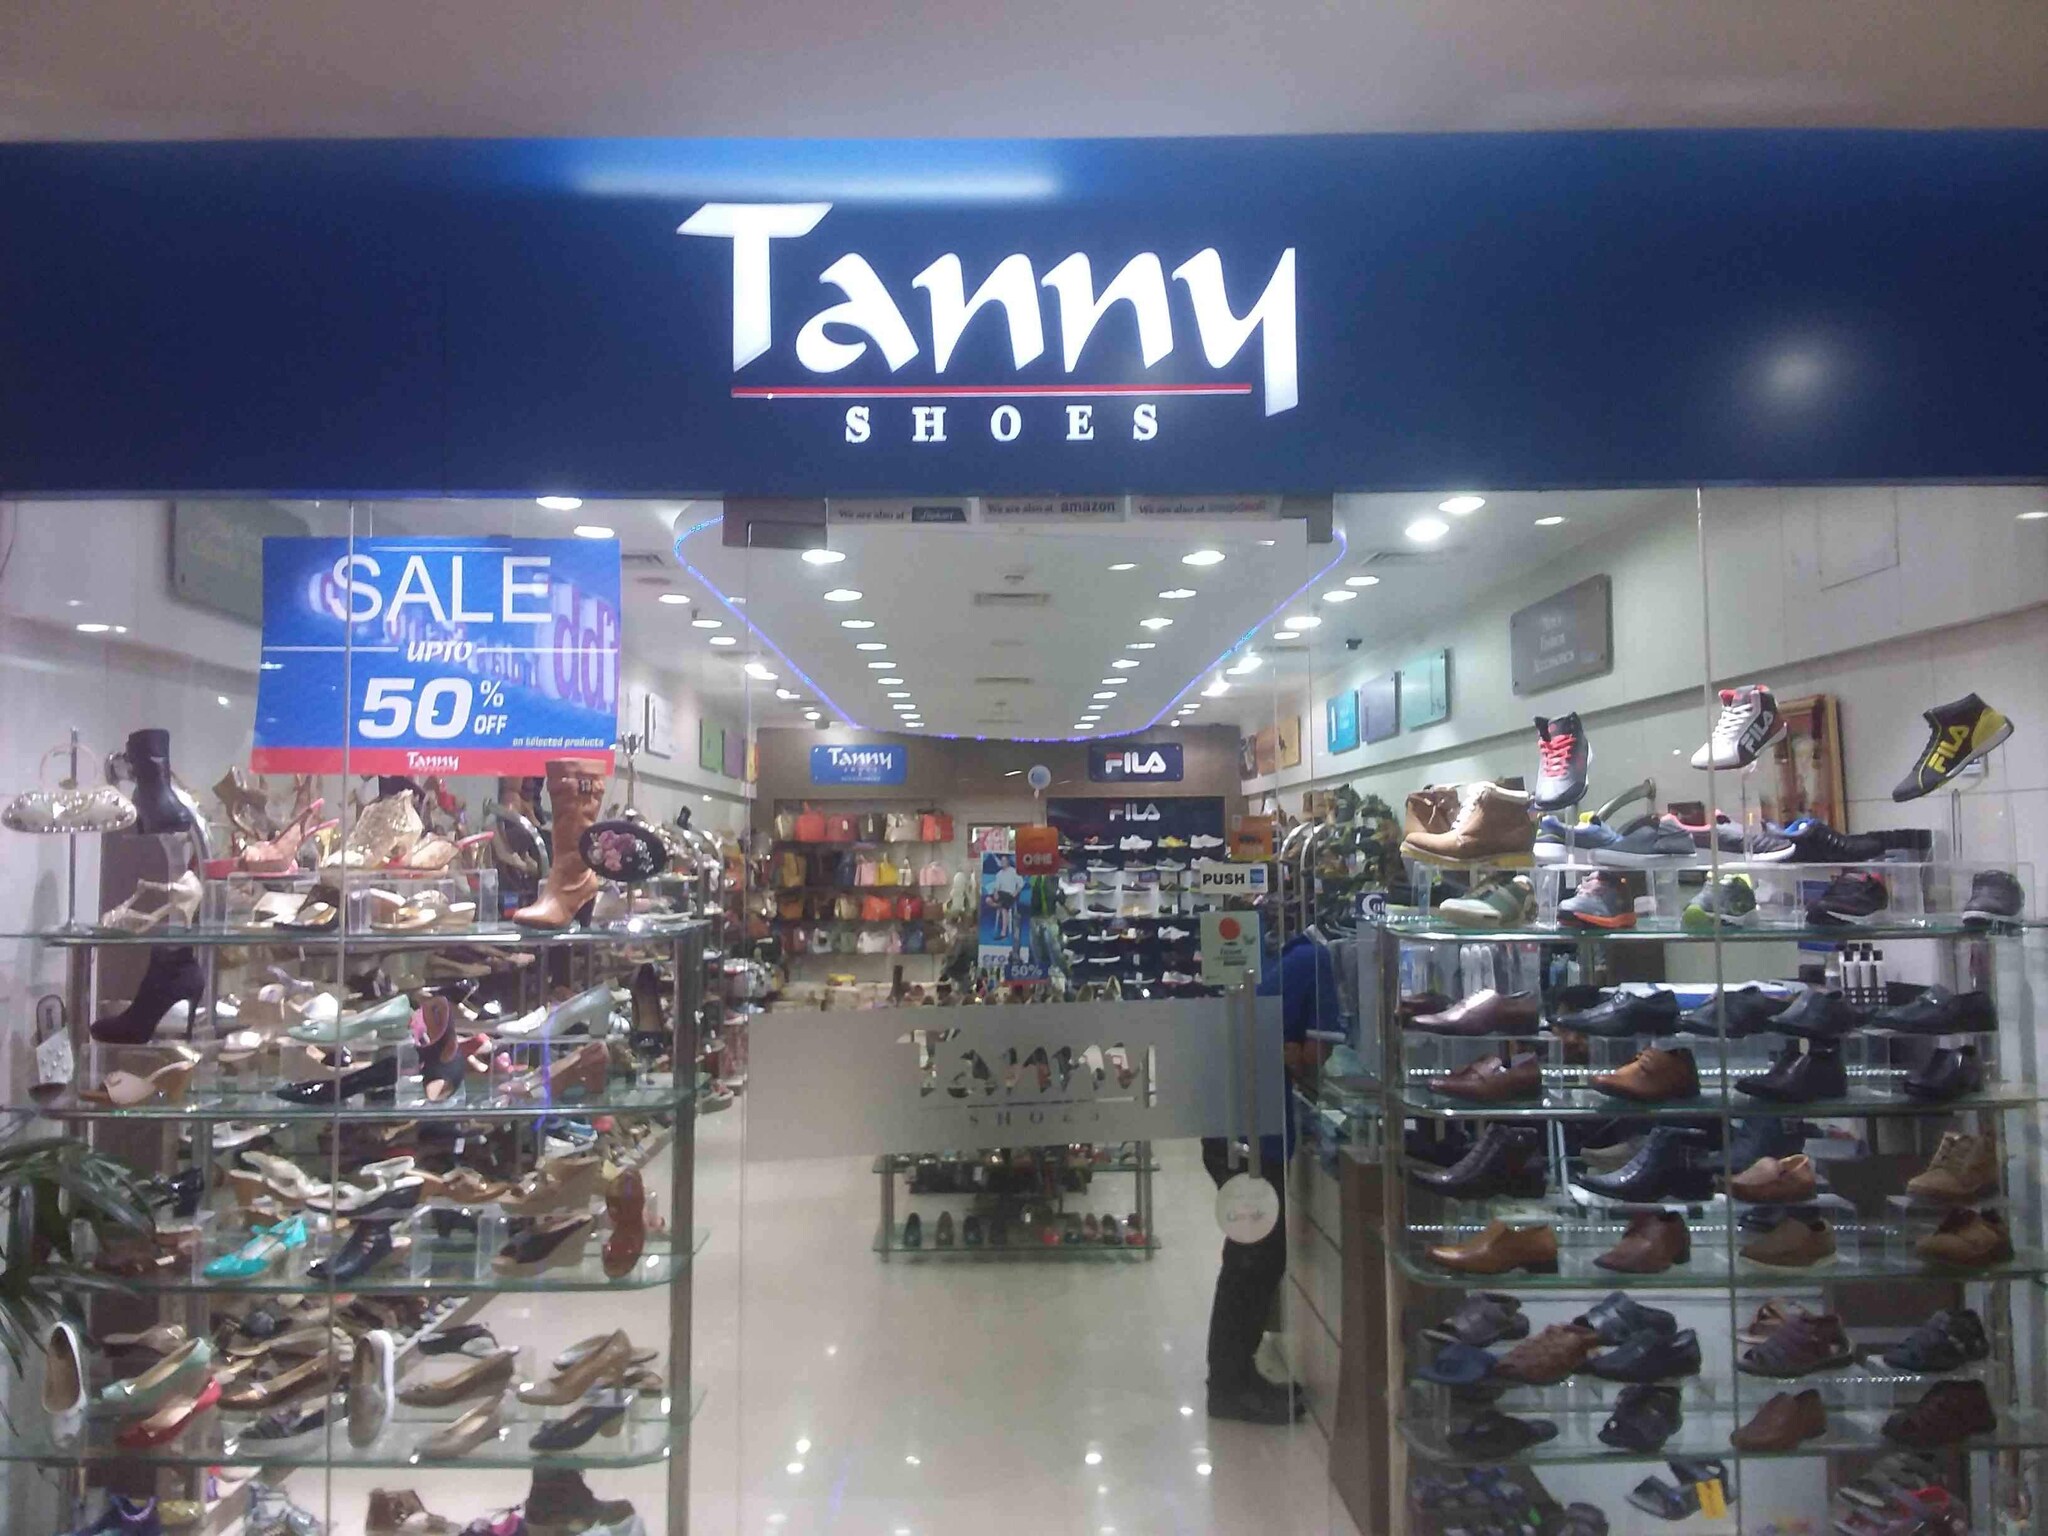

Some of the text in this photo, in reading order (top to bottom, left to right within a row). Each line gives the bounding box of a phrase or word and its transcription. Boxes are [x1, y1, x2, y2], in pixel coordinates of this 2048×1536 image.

[677, 202, 1299, 417] Tanny
[845, 403, 1158, 444] SHOES
[1061, 501, 1115, 512] amazon
[333, 554, 552, 623] SALE
[407, 641, 473, 663] UPTO
[473, 714, 508, 735] OFF
[1740, 711, 1774, 753] FILA
[565, 737, 604, 748] products
[1926, 725, 1970, 774] FILA
[407, 751, 460, 771] Tanny
[827, 748, 892, 770] Tanny
[1105, 751, 1167, 774] FILA
[1108, 803, 1161, 821] FILA
[1202, 873, 1245, 885] PUSH
[896, 1028, 1156, 1107] Tanny
